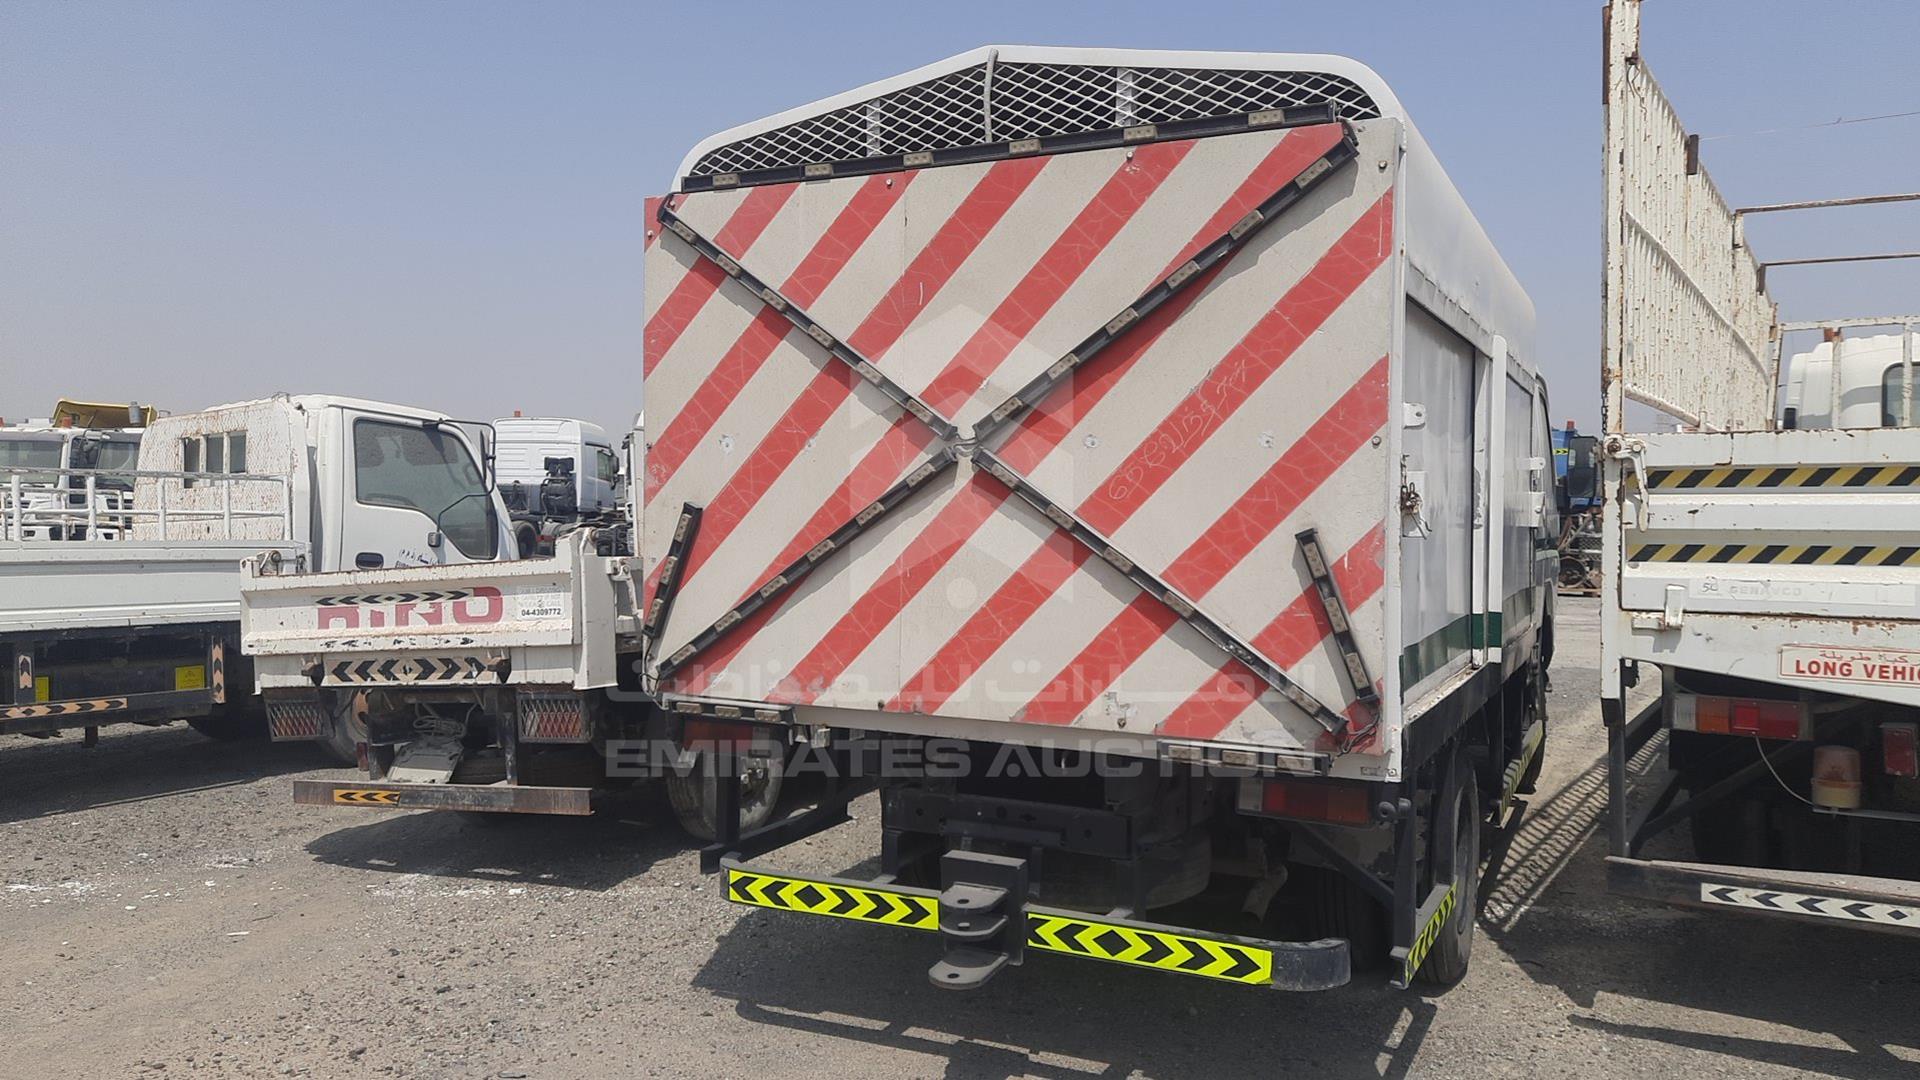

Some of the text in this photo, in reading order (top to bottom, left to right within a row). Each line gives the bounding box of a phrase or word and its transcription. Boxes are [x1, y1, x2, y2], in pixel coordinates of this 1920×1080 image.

[521, 608, 562, 616] 04-4309772
[1795, 659, 1920, 684] LONG VEHI
